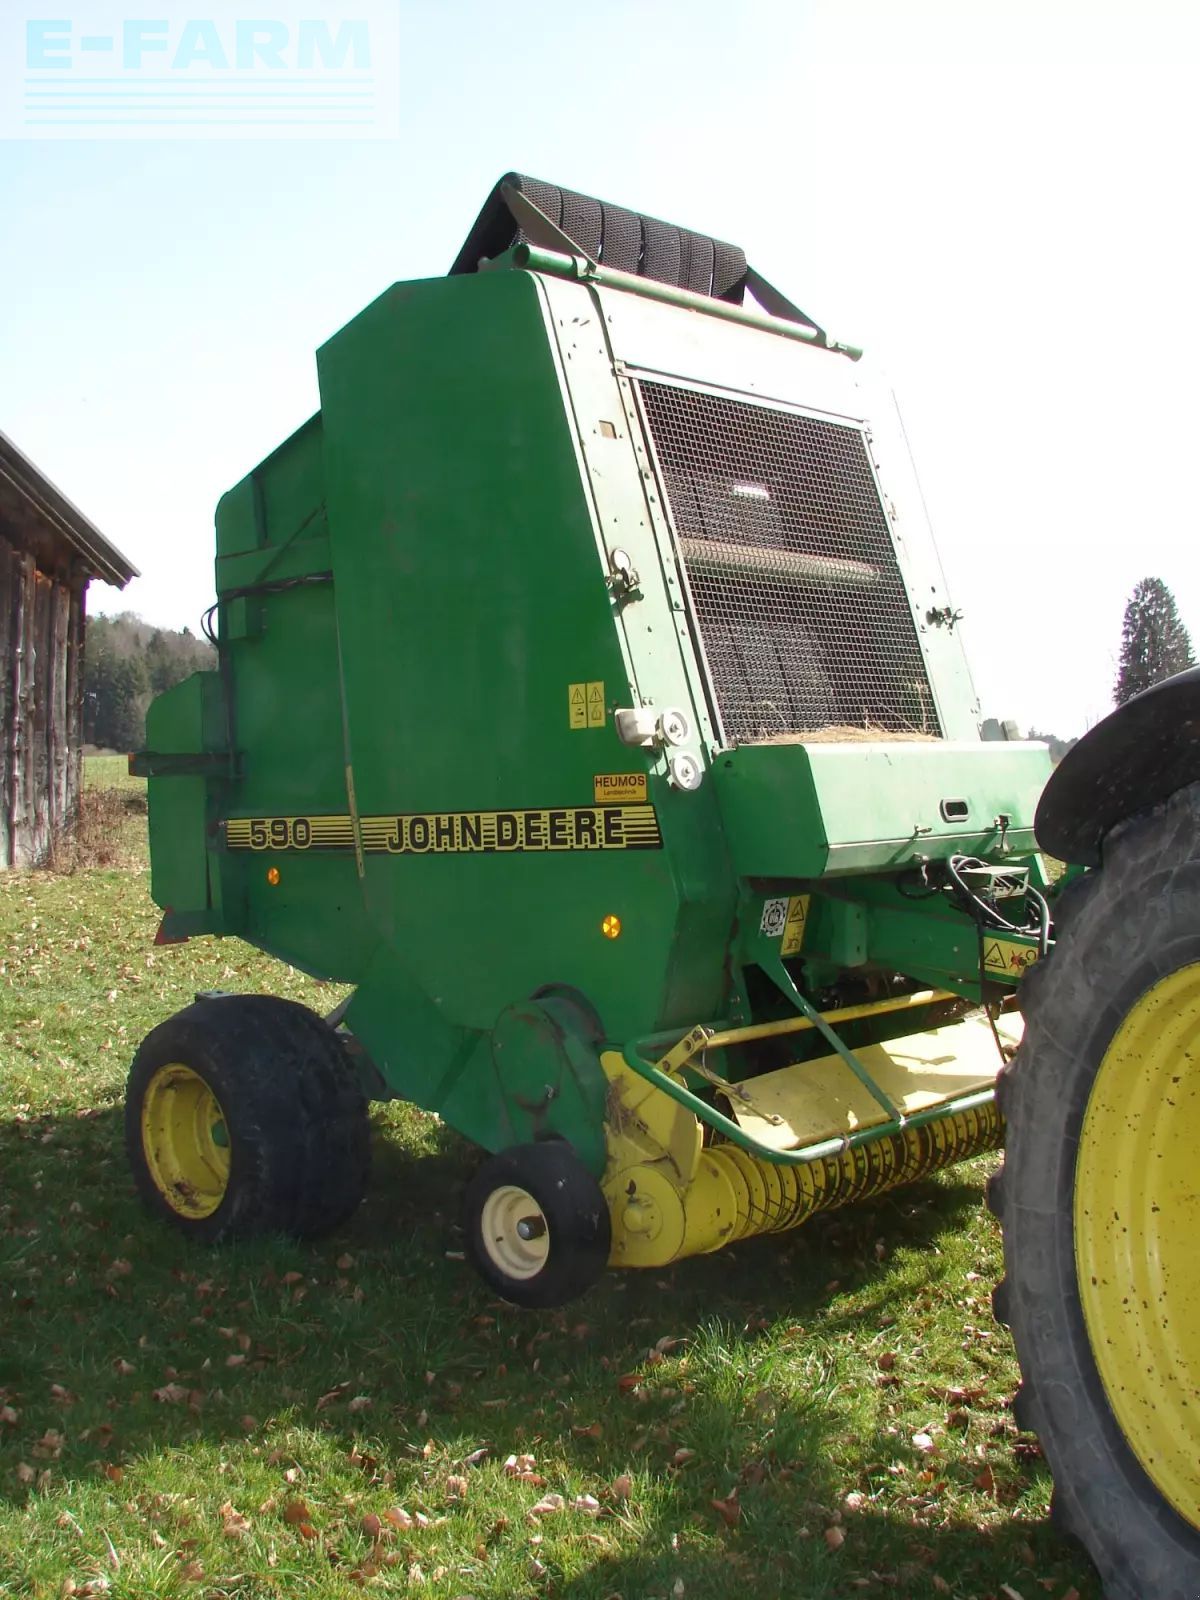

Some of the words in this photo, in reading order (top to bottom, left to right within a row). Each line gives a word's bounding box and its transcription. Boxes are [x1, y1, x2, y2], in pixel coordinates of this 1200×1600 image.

[595, 775, 645, 787] HEUMOS
[250, 818, 311, 849] 590
[387, 815, 483, 852] JOHN
[495, 809, 625, 849] DEERE
